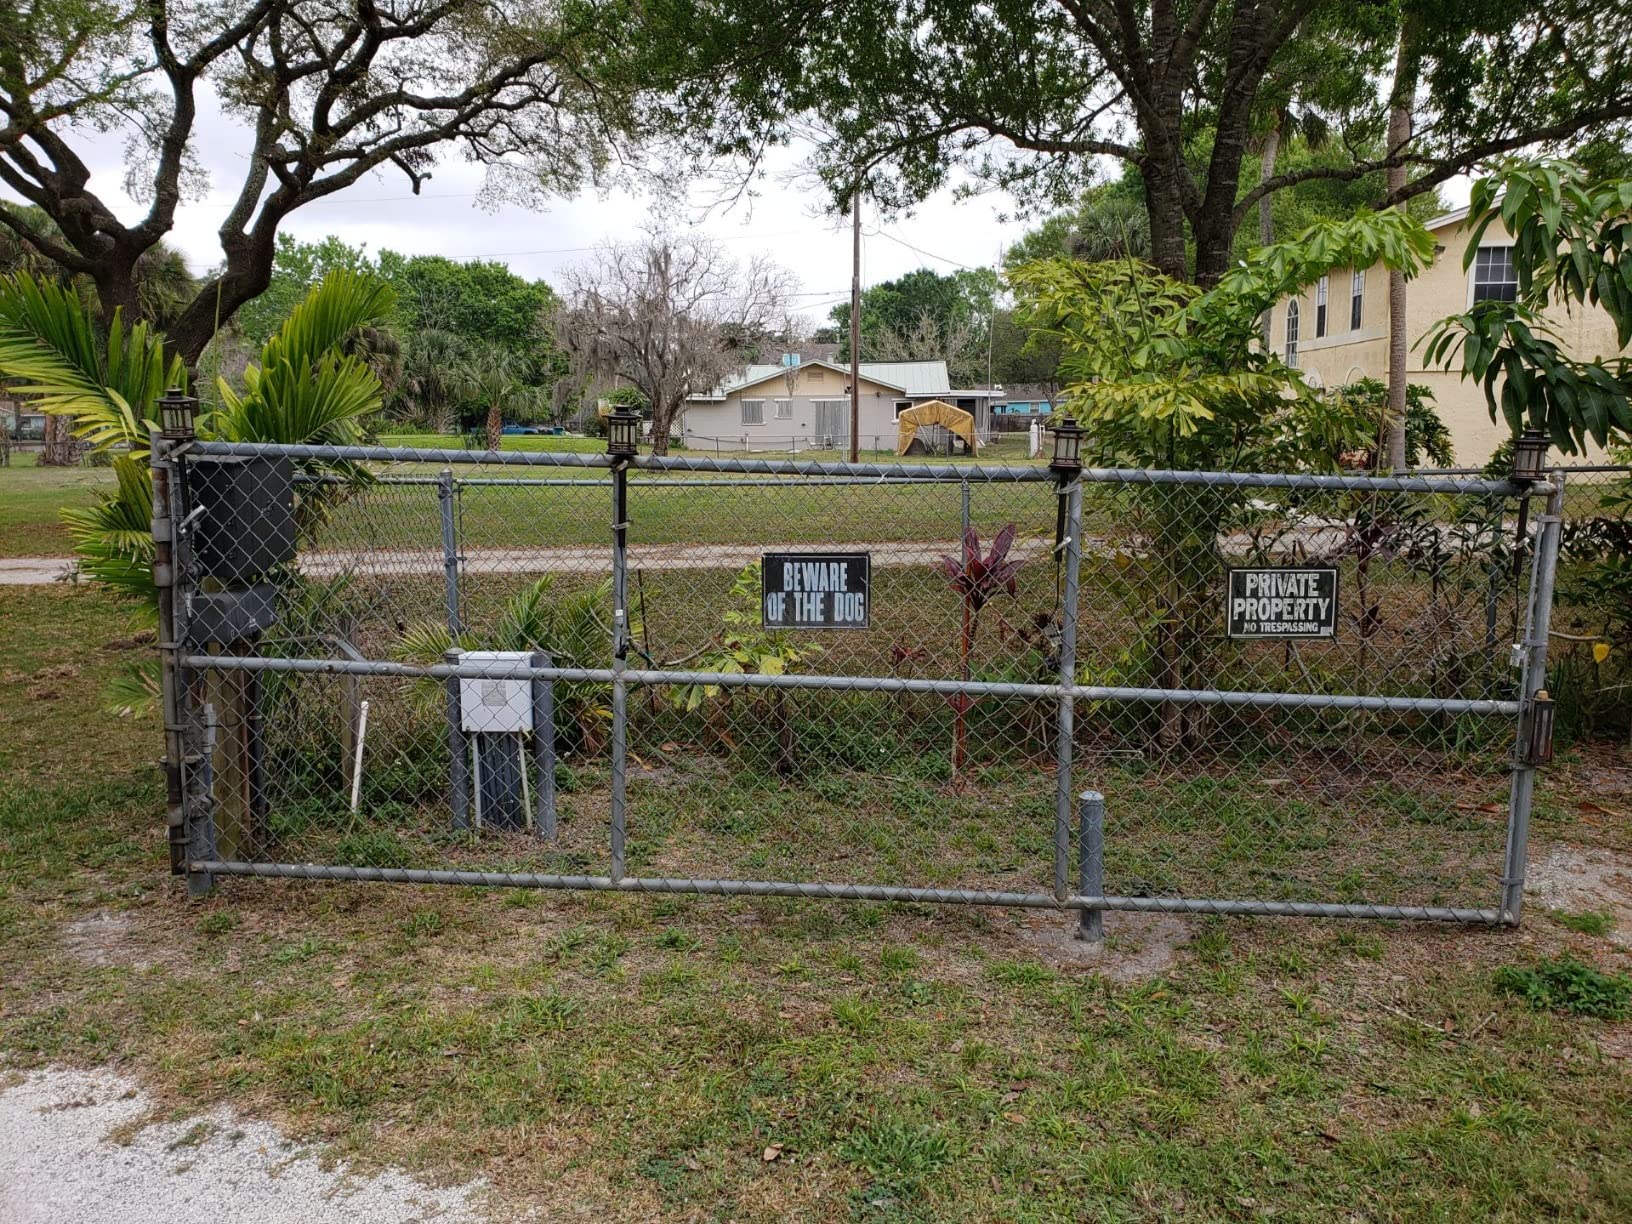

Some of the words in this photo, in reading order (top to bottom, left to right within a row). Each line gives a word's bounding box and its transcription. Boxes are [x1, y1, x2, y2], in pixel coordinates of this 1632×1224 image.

[784, 562, 848, 591] BEWARE
[1246, 573, 1320, 597] PRIVATE
[767, 592, 786, 621] OF
[794, 592, 824, 621] THE
[834, 592, 864, 621] DOG
[1233, 597, 1330, 620] PROPERTY
[1244, 622, 1257, 632] NO
[1260, 622, 1318, 632] TRESPASSING
